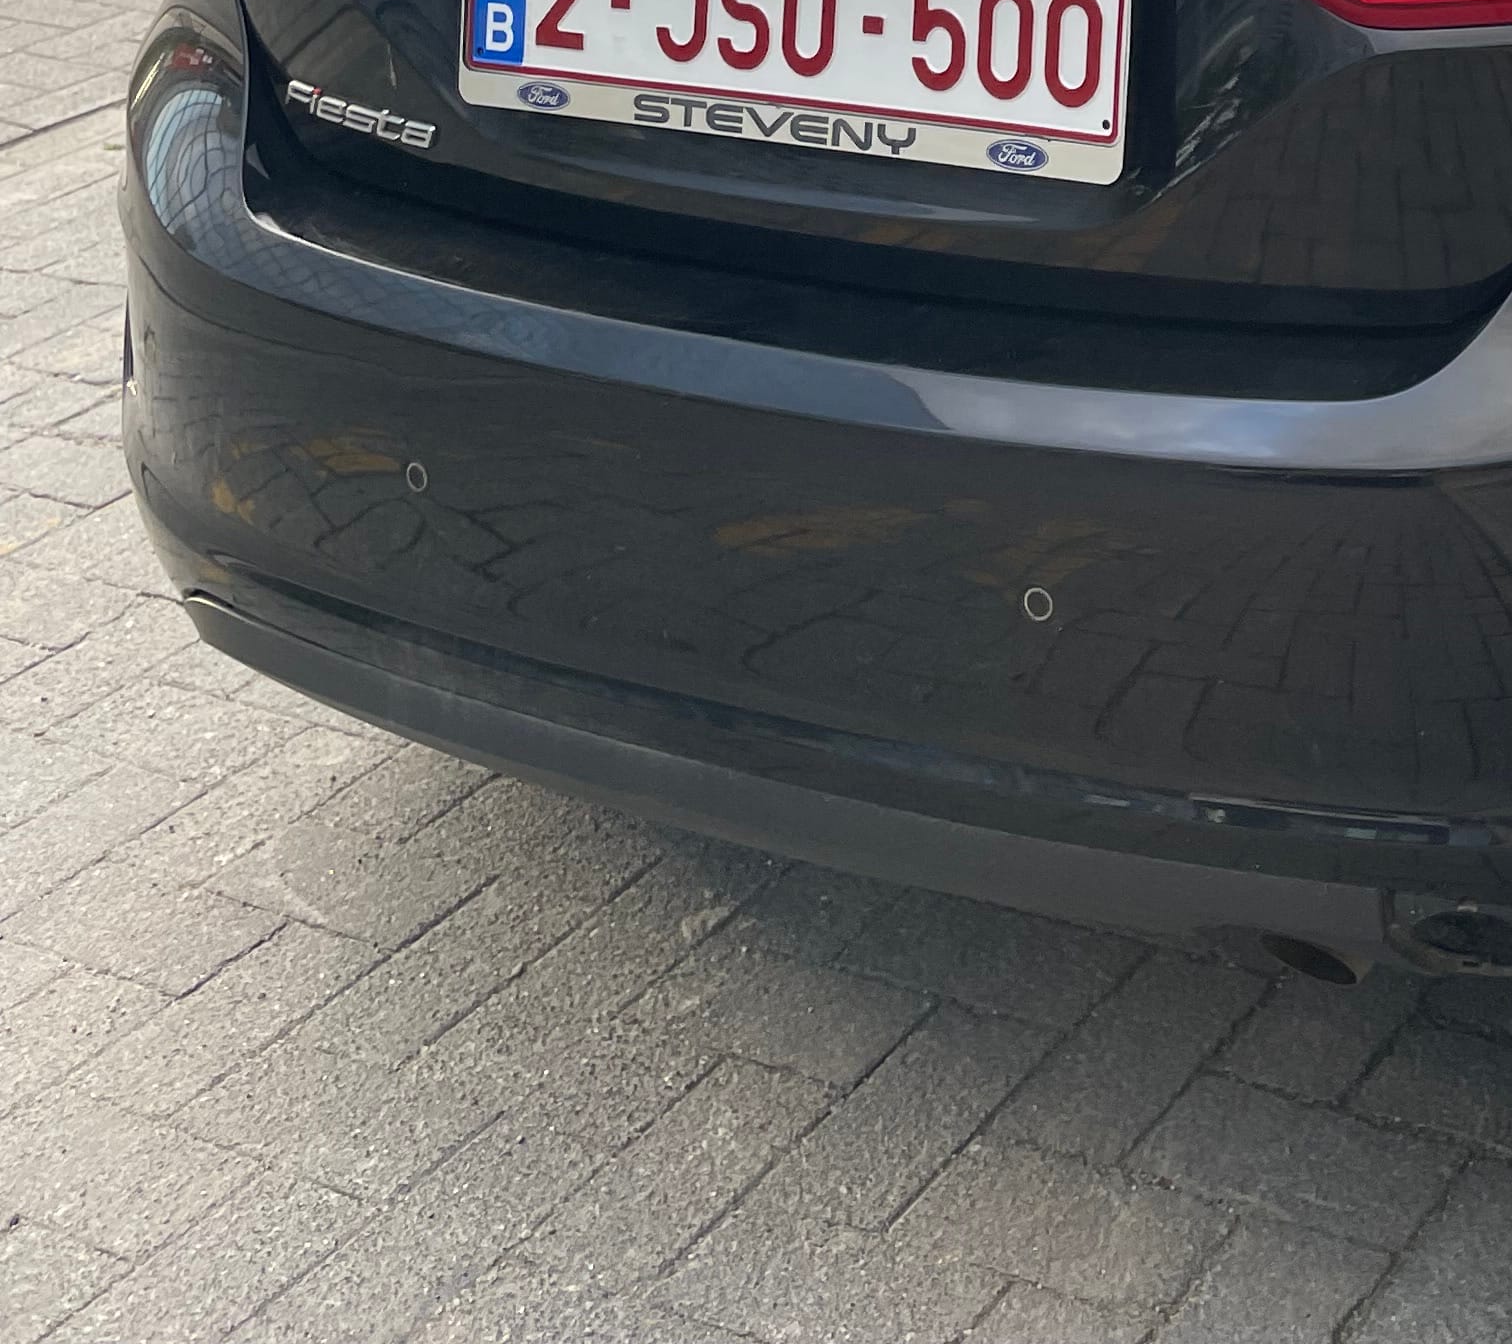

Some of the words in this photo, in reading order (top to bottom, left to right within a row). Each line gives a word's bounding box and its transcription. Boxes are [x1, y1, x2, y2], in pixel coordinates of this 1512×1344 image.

[484, 2, 515, 54] B
[285, 79, 436, 149] Fiesta
[527, 85, 560, 107] Ford
[633, 93, 917, 155] STEVENY
[998, 143, 1037, 166] Ford
